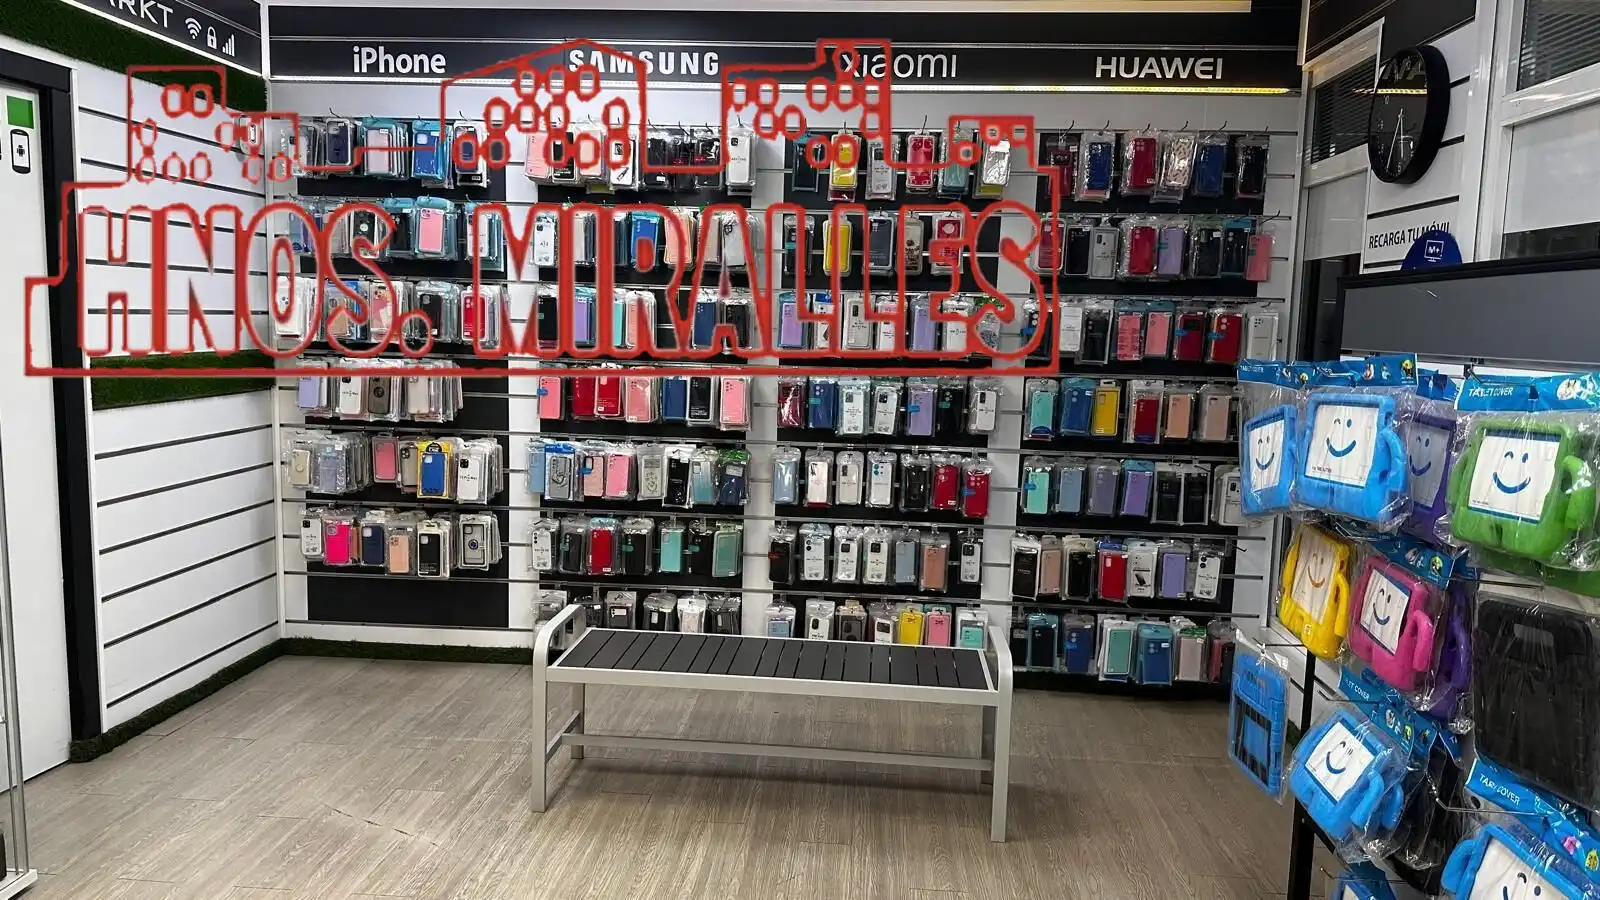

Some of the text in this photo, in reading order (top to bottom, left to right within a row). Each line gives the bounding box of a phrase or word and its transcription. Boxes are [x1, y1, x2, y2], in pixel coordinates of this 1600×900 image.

[352, 47, 446, 74] iPhone
[569, 50, 719, 75] SAMSUNG
[1095, 56, 1222, 79] HUAWEI
[1369, 230, 1405, 249] RECARGA
[1407, 227, 1420, 243] TU
